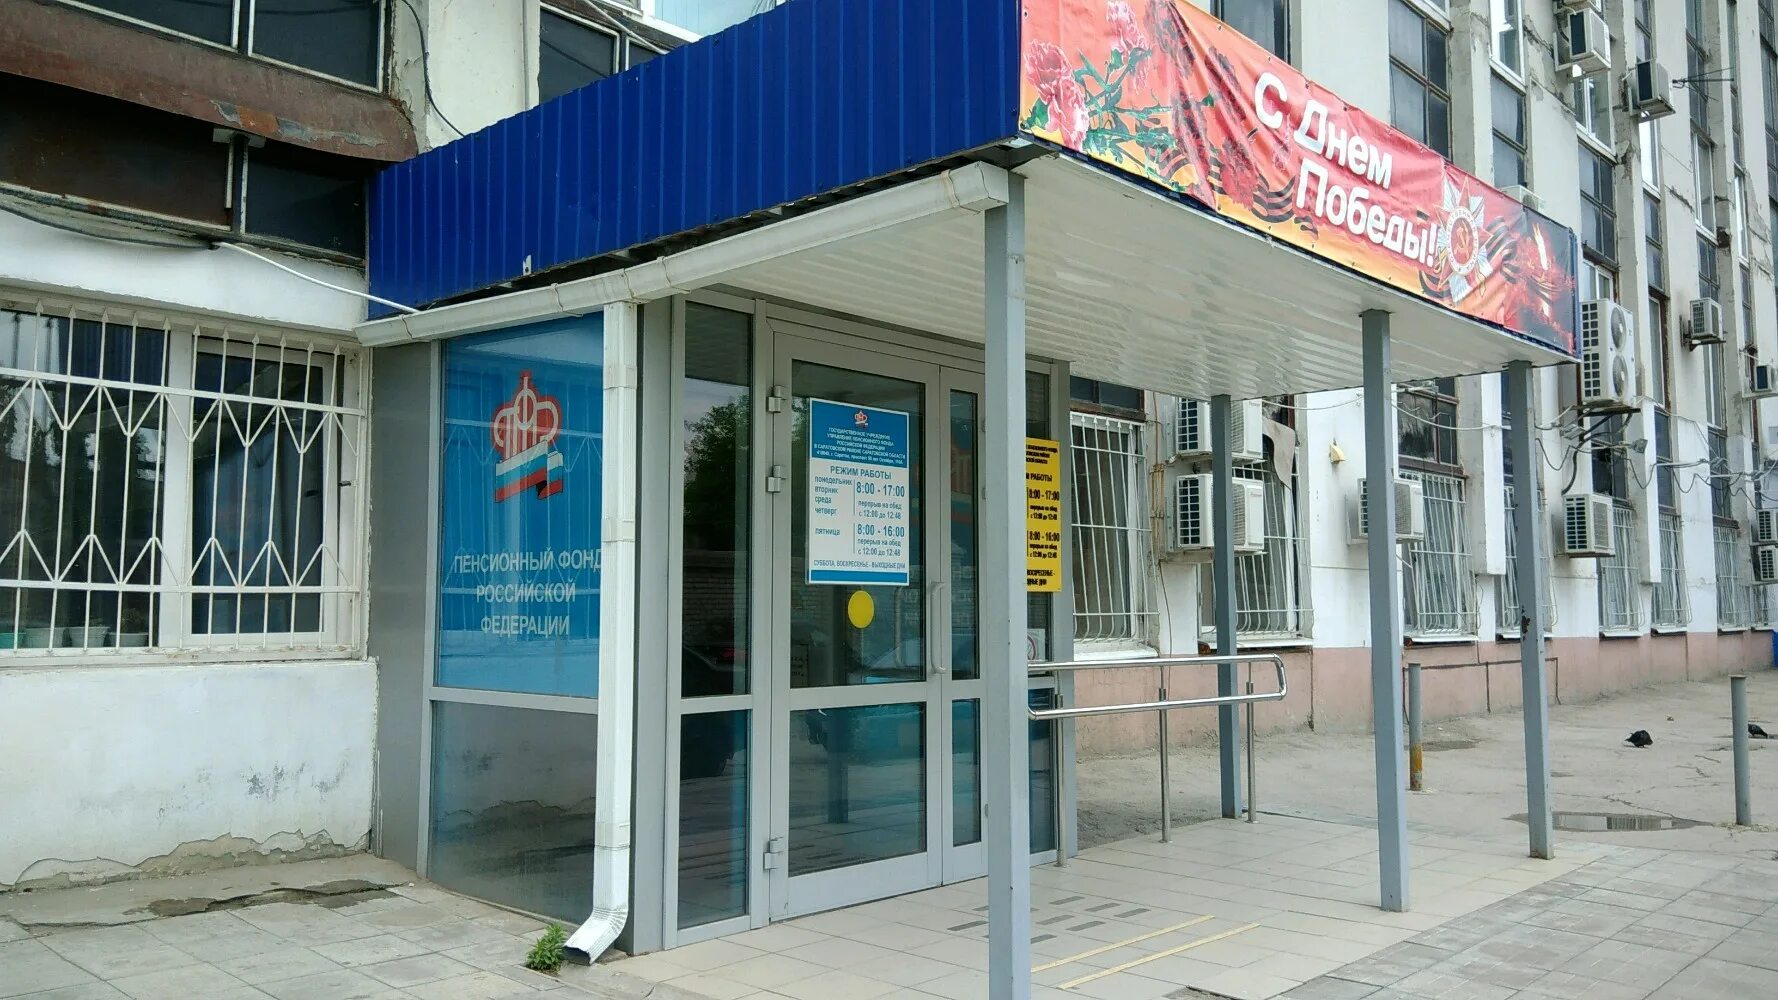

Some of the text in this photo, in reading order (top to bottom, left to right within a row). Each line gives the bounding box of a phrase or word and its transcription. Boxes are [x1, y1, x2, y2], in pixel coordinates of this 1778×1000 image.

[1255, 72, 1393, 189] С Днем
[1296, 157, 1437, 268] Победы!
[830, 466, 891, 480] РЕЖИМ РАБОТЫ
[815, 476, 852, 485] понедельник
[815, 486, 838, 494] вторник
[856, 482, 874, 494] 8:00
[883, 484, 904, 497] 17:00
[815, 507, 837, 516] четверг
[815, 528, 840, 536] пятница
[857, 524, 874, 535] 8:00
[883, 525, 904, 537] 16:00
[454, 547, 554, 573] ПЕНСИОННЫЙ
[476, 578, 576, 603] РОССИЙСКОЙ
[480, 615, 570, 638] ФЕДЕРАЦИИ
